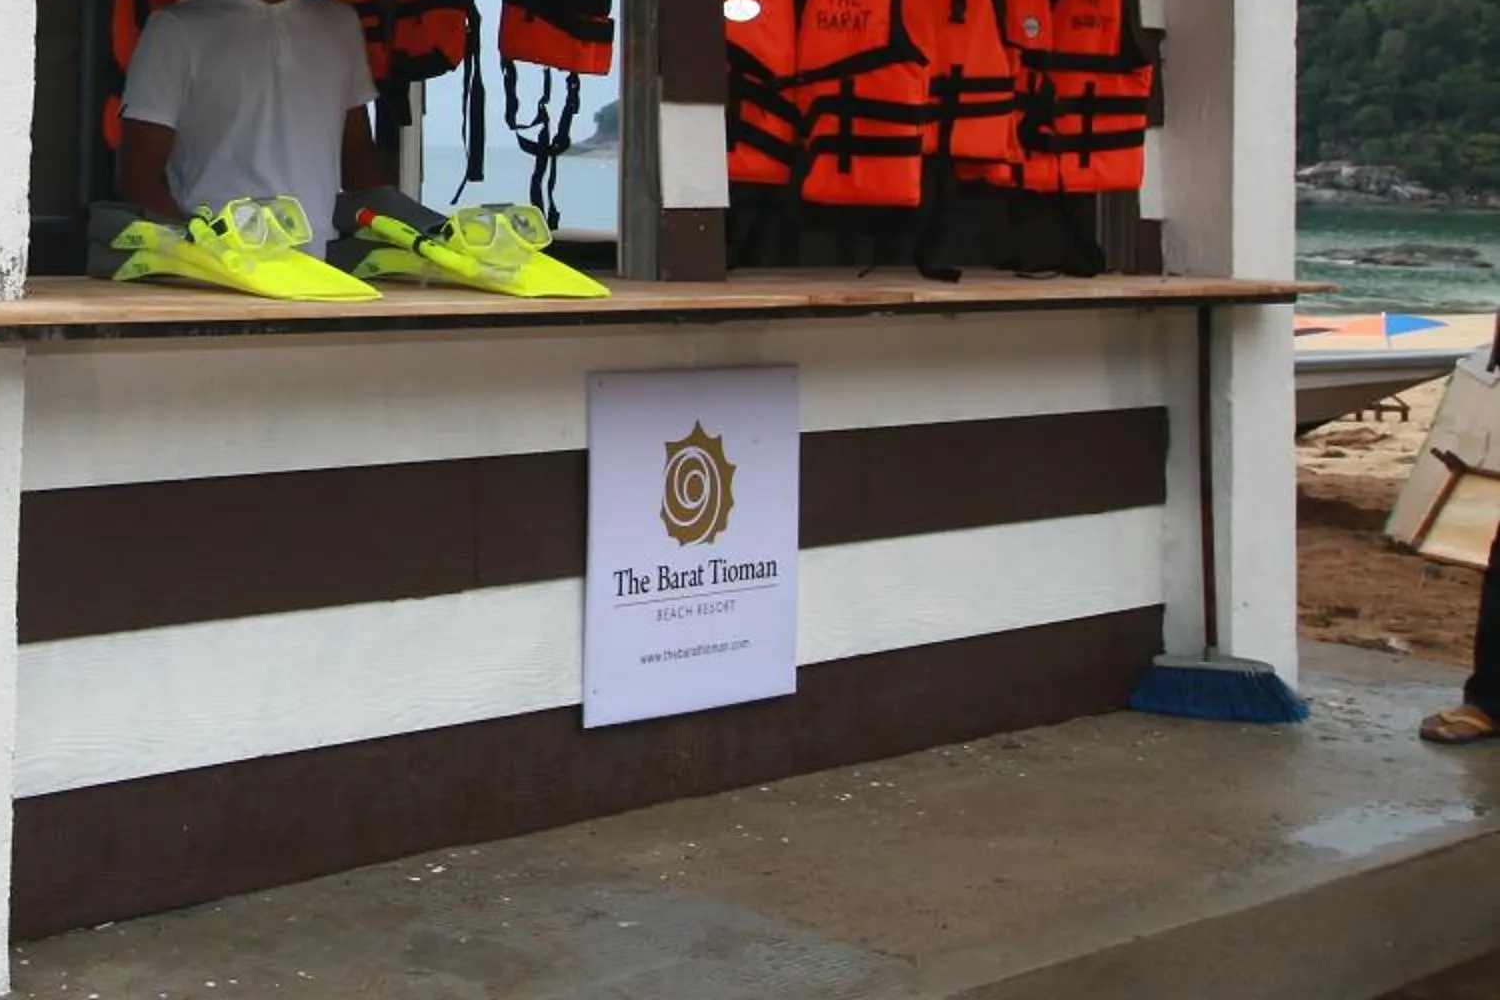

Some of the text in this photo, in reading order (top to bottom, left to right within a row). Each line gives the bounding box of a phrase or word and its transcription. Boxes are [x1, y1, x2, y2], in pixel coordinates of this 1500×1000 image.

[816, 9, 873, 33] BARAT
[613, 558, 778, 597] The Barat Tioman
[656, 600, 736, 621] BEACH RESORT
